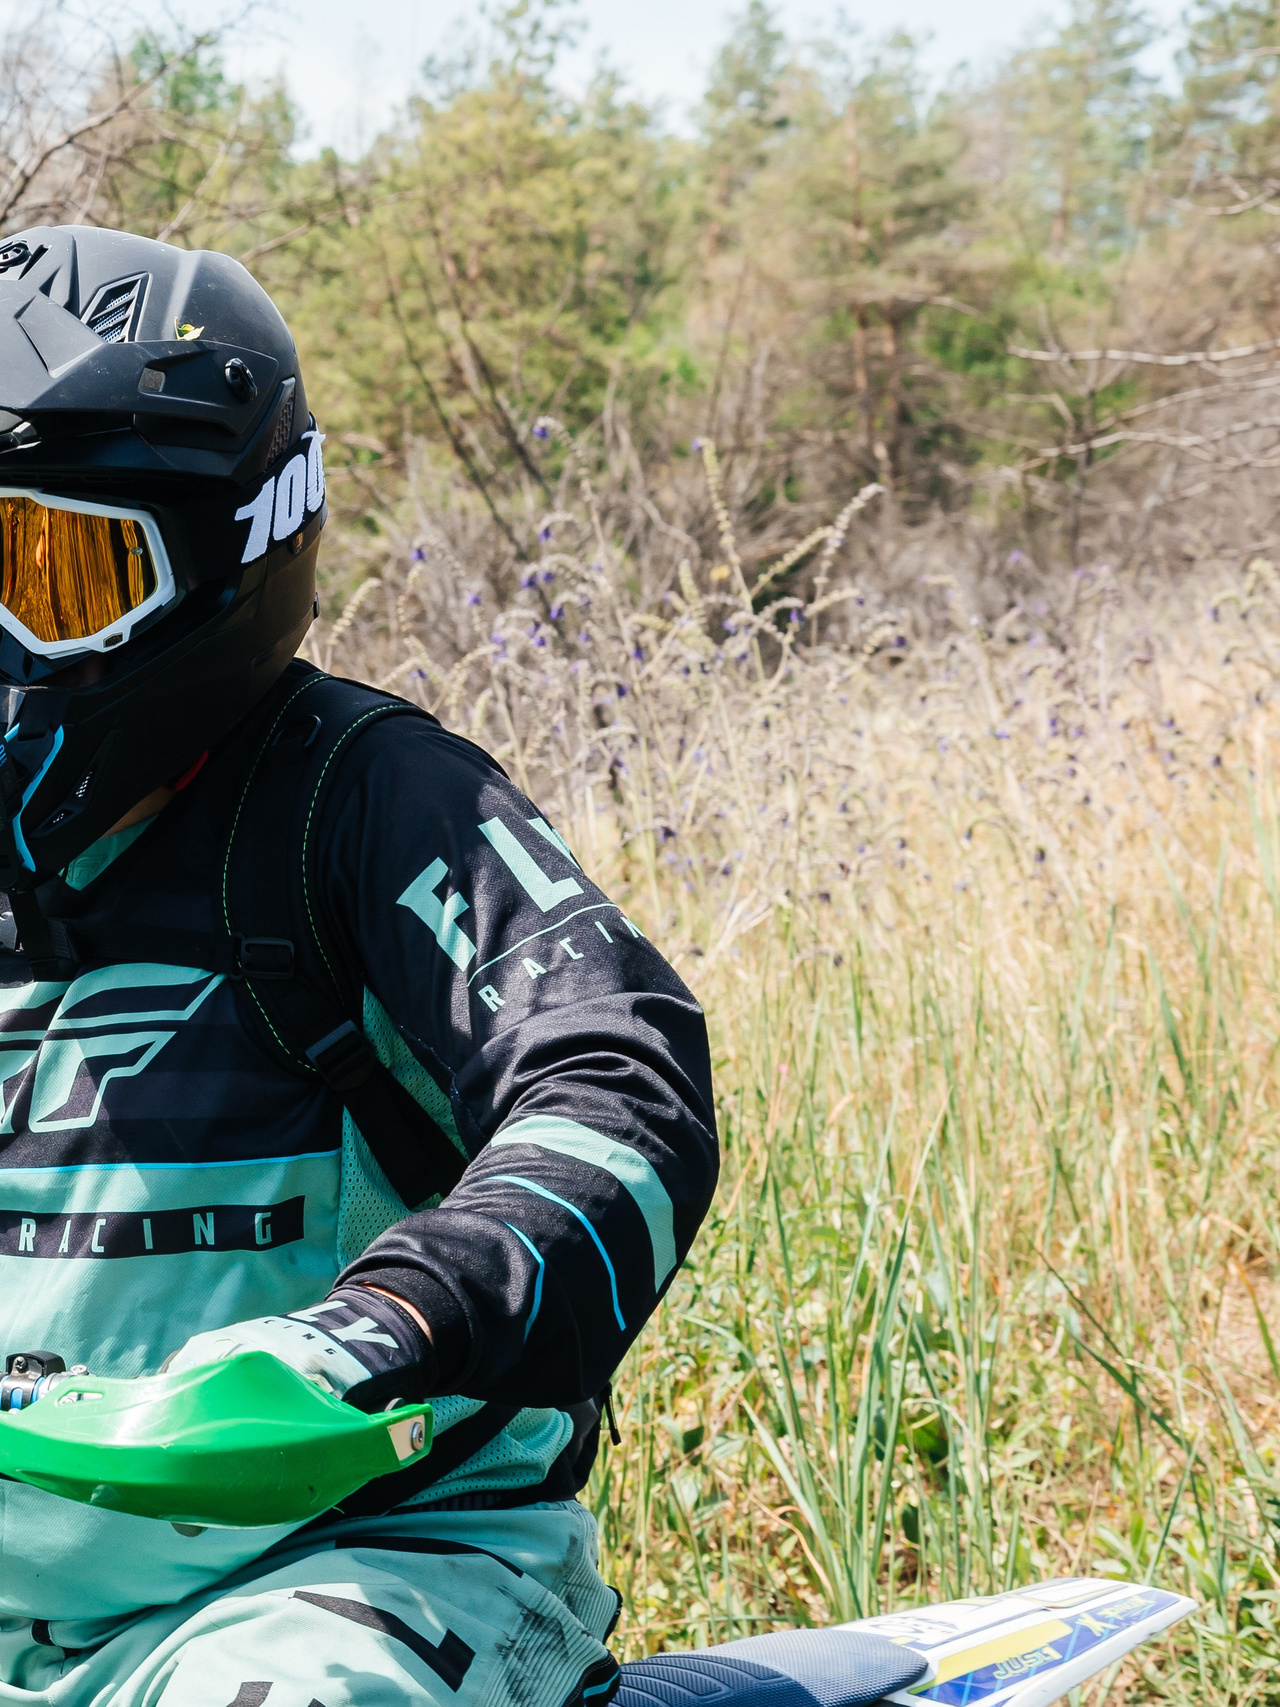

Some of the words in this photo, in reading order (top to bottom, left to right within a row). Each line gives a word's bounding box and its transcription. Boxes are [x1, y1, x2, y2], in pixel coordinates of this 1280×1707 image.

[478, 917, 646, 1012] RACIN
[19, 1212, 272, 1253] RACING
[263, 1319, 337, 1355] CING
[288, 1300, 400, 1349] LY
